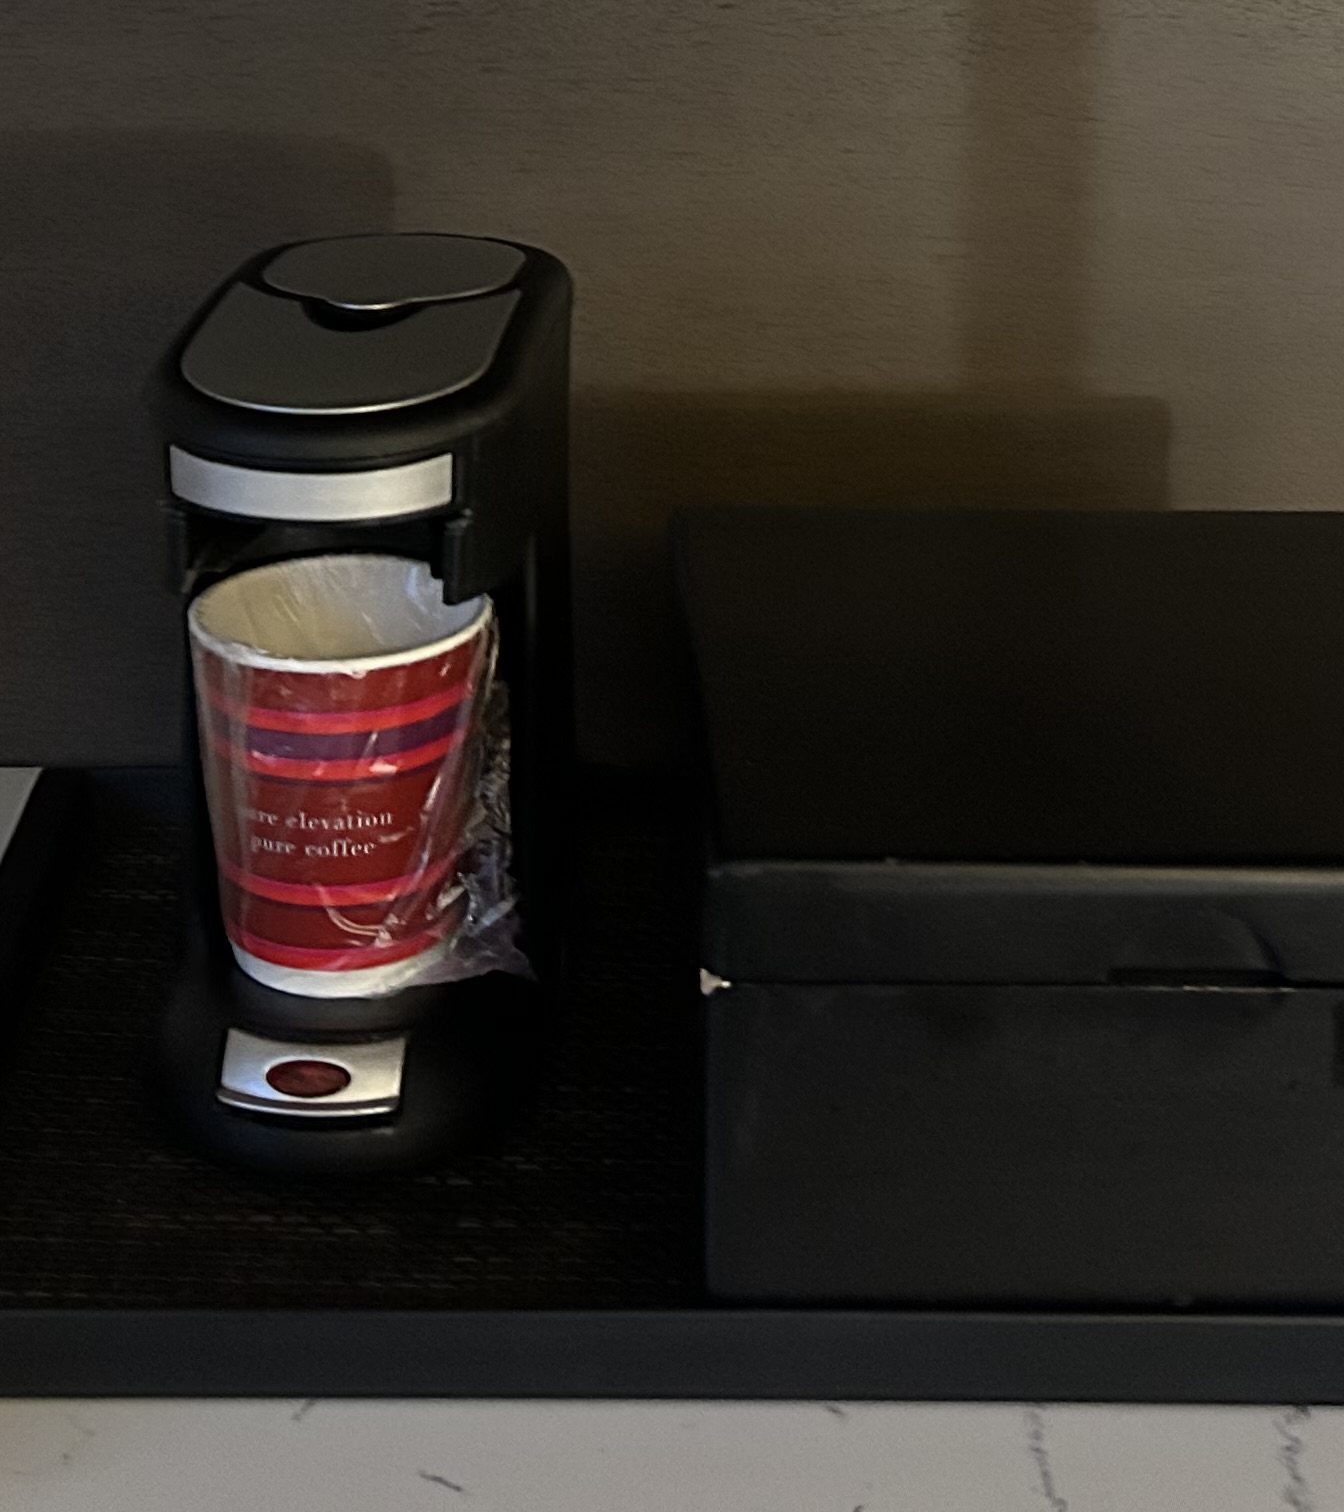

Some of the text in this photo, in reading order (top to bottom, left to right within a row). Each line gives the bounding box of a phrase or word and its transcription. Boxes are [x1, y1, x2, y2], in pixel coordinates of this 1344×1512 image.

[285, 809, 394, 830] elevation
[250, 834, 377, 857] pure coffee
